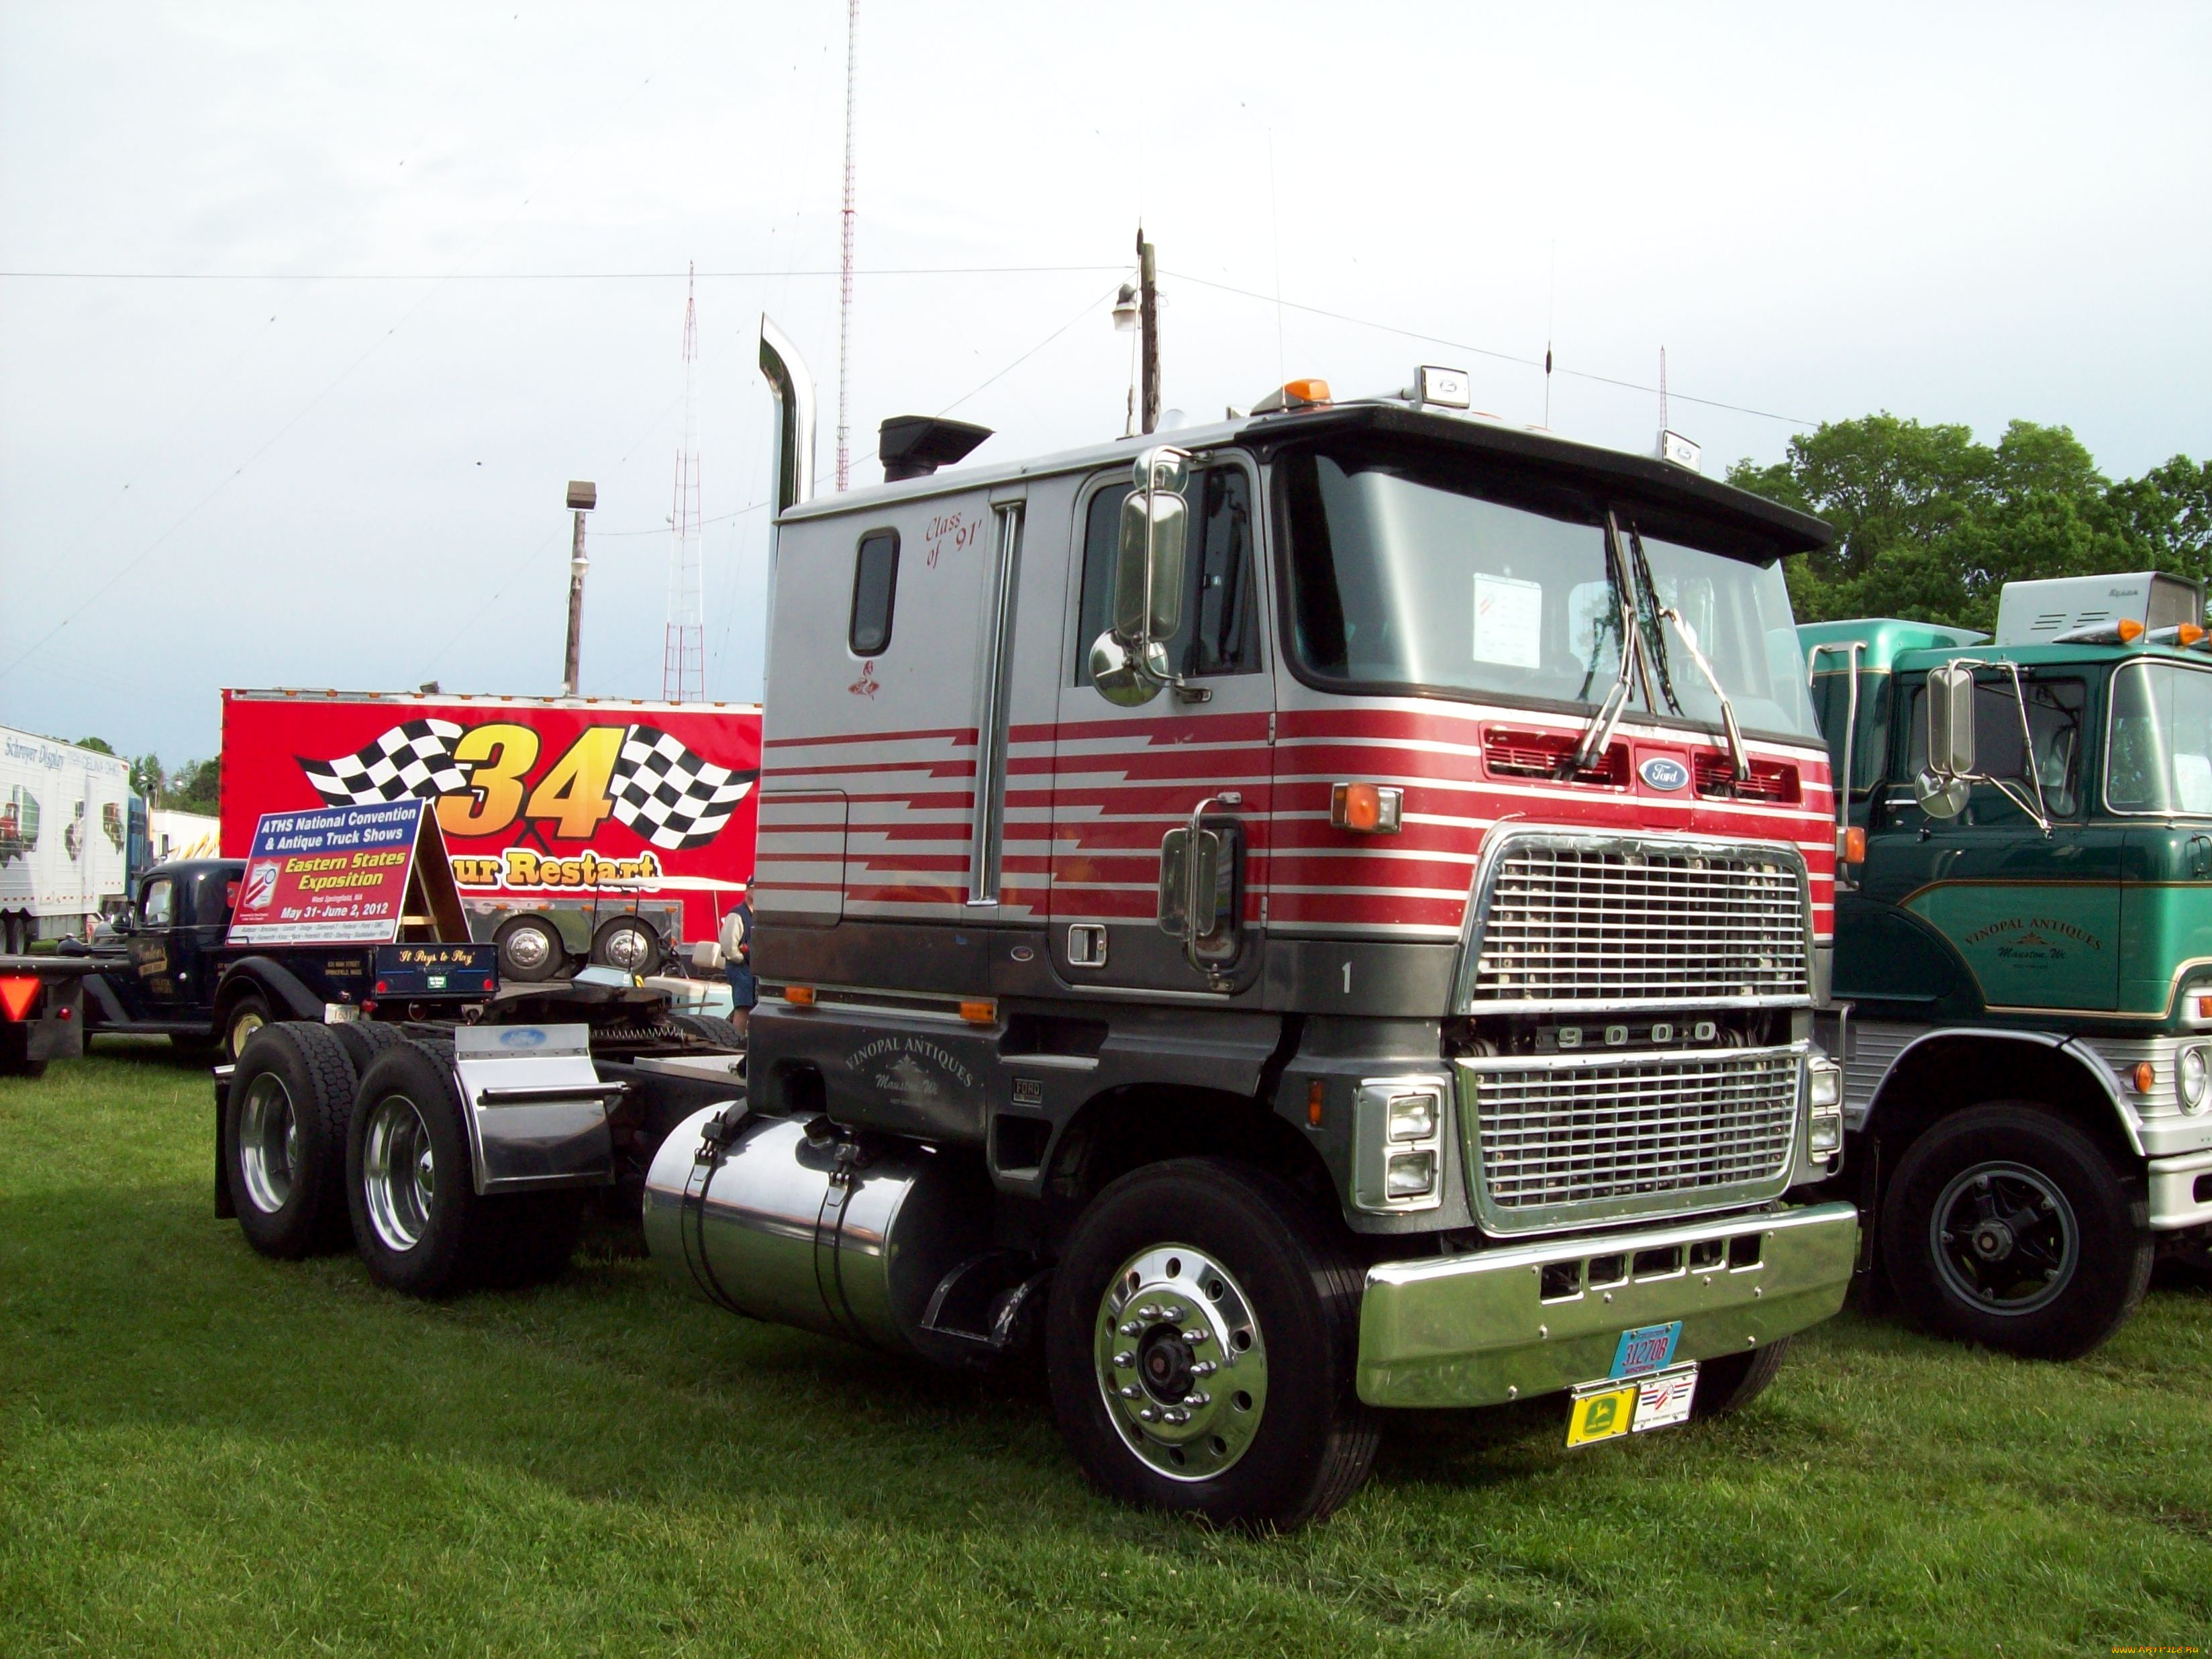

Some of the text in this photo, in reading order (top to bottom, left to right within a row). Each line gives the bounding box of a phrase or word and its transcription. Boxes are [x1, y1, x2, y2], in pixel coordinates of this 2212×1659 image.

[926, 512, 962, 542] Class
[926, 540, 942, 569] of
[436, 723, 627, 839] 34
[1652, 764, 1678, 782] Ford
[261, 808, 417, 834] ATHS National Convention
[264, 827, 403, 851] & Antique Truck Shows
[285, 856, 348, 873] Eastern
[351, 852, 406, 868] States
[505, 851, 657, 887] Restart
[297, 872, 384, 893] Exposition
[281, 907, 301, 921] May
[350, 904, 360, 917] 2,
[362, 902, 389, 916] 2012
[1964, 918, 2103, 951] VINOPAL ANTIQUES
[413, 950, 438, 966] Pays
[440, 950, 450, 962] to
[1341, 960, 1352, 994] 1
[1558, 1021, 1717, 1049] 9000
[844, 1036, 974, 1088] VINOPAL ANTIQUES
[1016, 1081, 1040, 1095] FORD
